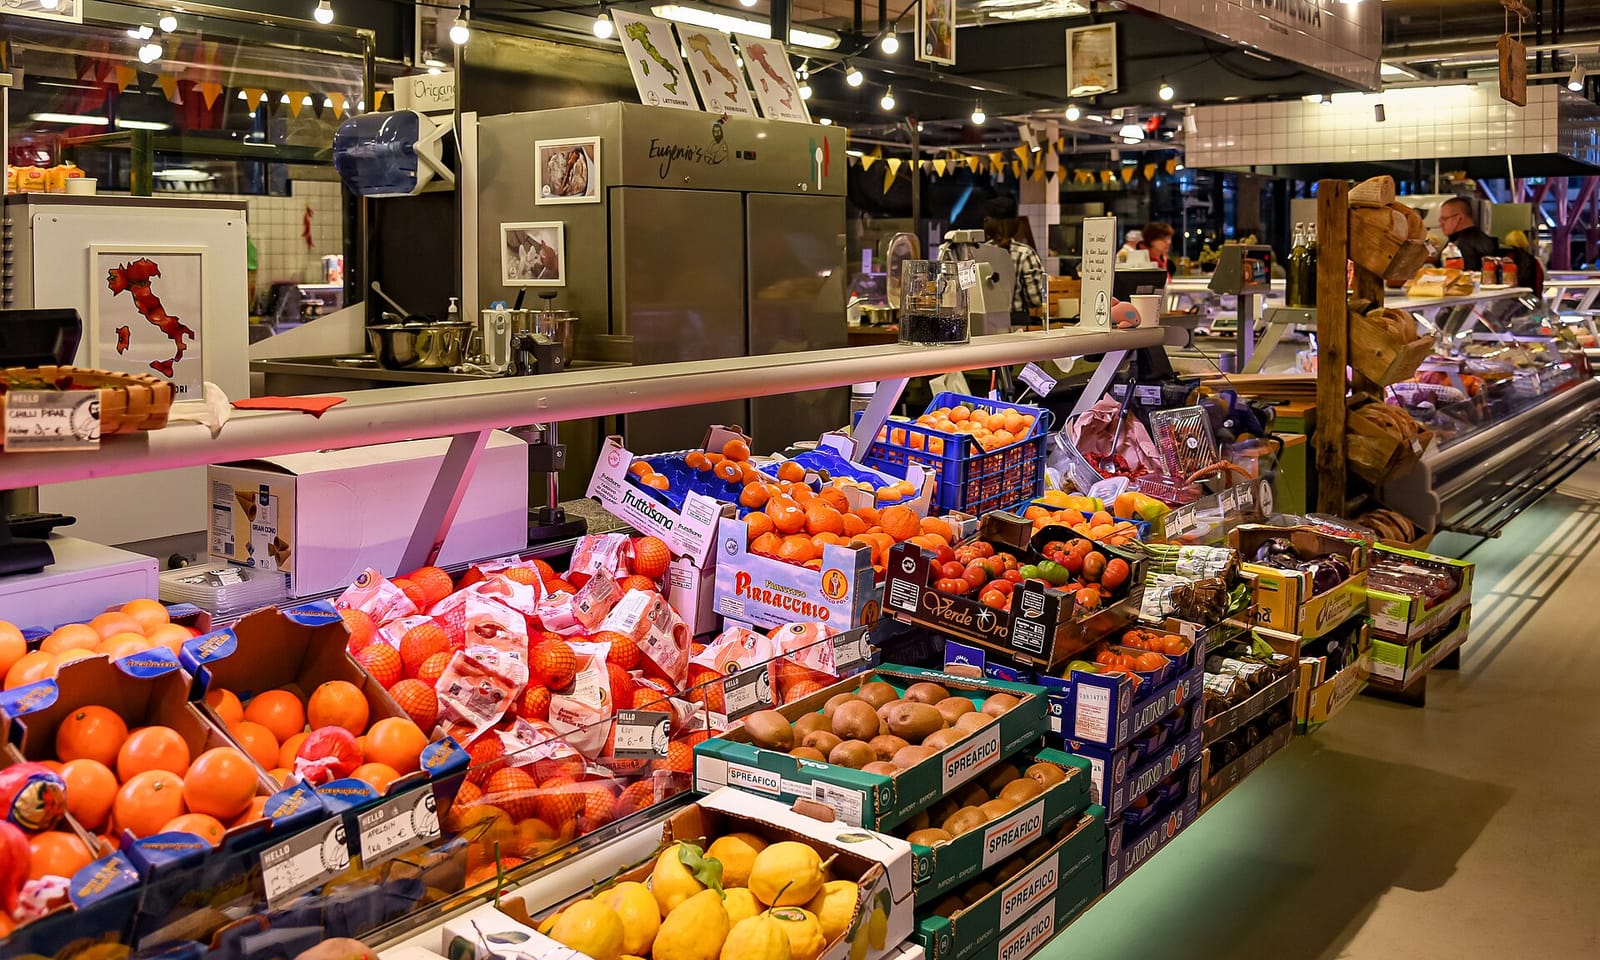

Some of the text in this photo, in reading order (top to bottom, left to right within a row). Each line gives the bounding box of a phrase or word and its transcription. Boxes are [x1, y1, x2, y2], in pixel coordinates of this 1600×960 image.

[649, 138, 702, 179] Eugenio's
[621, 489, 674, 531] fruttasana
[922, 590, 973, 627] Verde
[976, 610, 1009, 638] Oro
[725, 678, 739, 688] HELLO
[948, 738, 997, 778] SPREAFICO
[731, 769, 777, 788] SPREAFICO
[363, 809, 384, 826] HELLO
[989, 815, 1040, 854] SPREAFICO
[264, 845, 290, 864] HELLO
[1004, 870, 1054, 915] SPREAFICO
[1002, 915, 1051, 960] SPREAFICO
